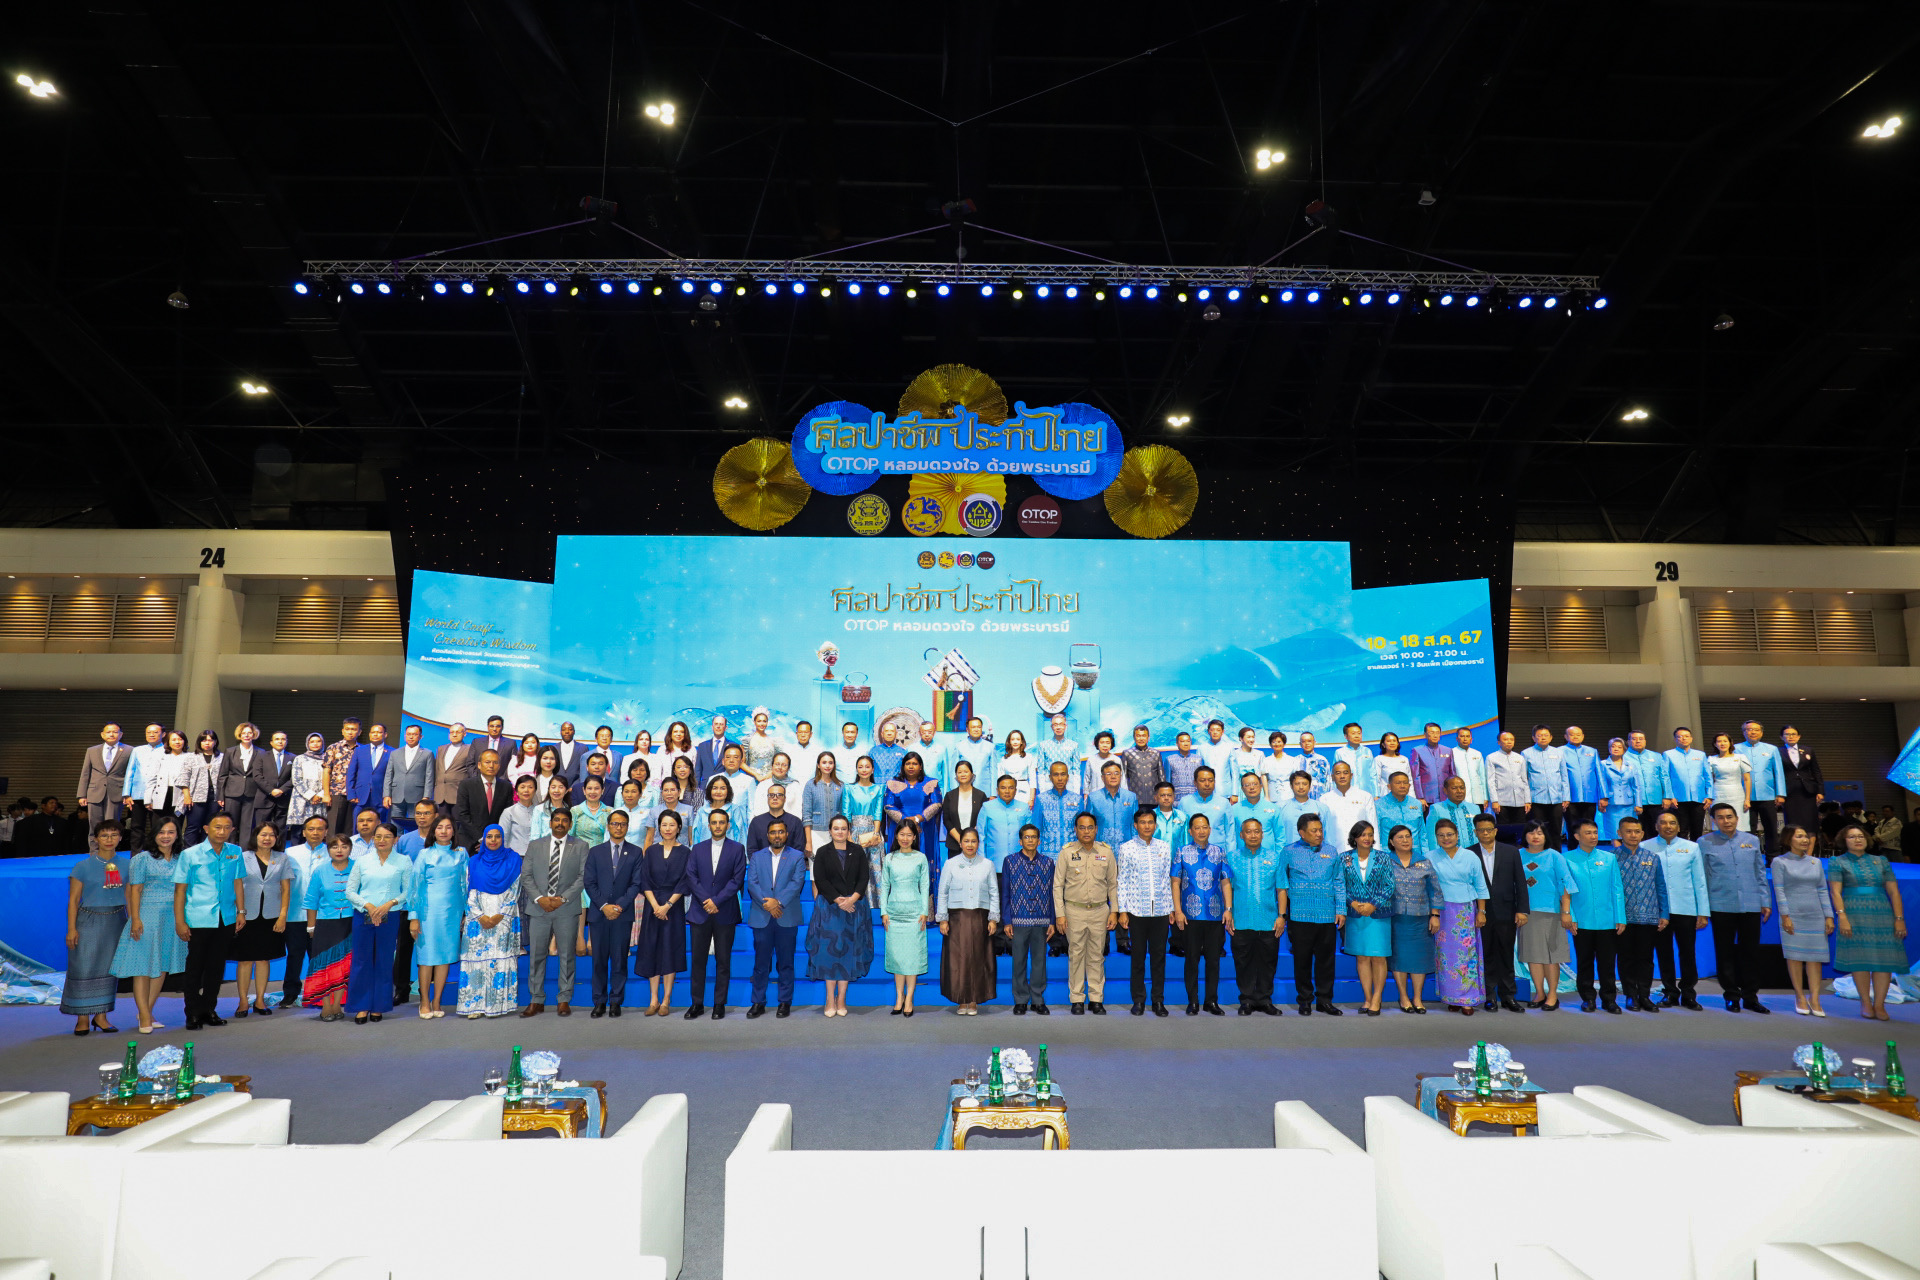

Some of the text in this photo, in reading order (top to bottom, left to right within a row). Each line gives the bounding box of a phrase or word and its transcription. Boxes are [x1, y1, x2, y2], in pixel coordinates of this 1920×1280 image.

[827, 457, 1091, 474] OTOP หลอมดวงใจ ด้วยพระบารมี
[1021, 508, 1058, 519] OTOP
[200, 547, 225, 568] 24
[1655, 561, 1679, 581] 29
[424, 617, 495, 636] World Craft
[844, 619, 1071, 633] OTOP หลอมดวงใจ ด้วยพระบารมี
[433, 632, 538, 651] Creative Wisdom
[1366, 636, 1387, 650] 10
[1400, 634, 1420, 648] 18
[1423, 634, 1456, 647] ส.ค.
[1459, 630, 1483, 645] 67
[1380, 653, 1398, 661] เวลา
[1400, 651, 1425, 660] 10.00
[1434, 649, 1458, 658] 21.00
